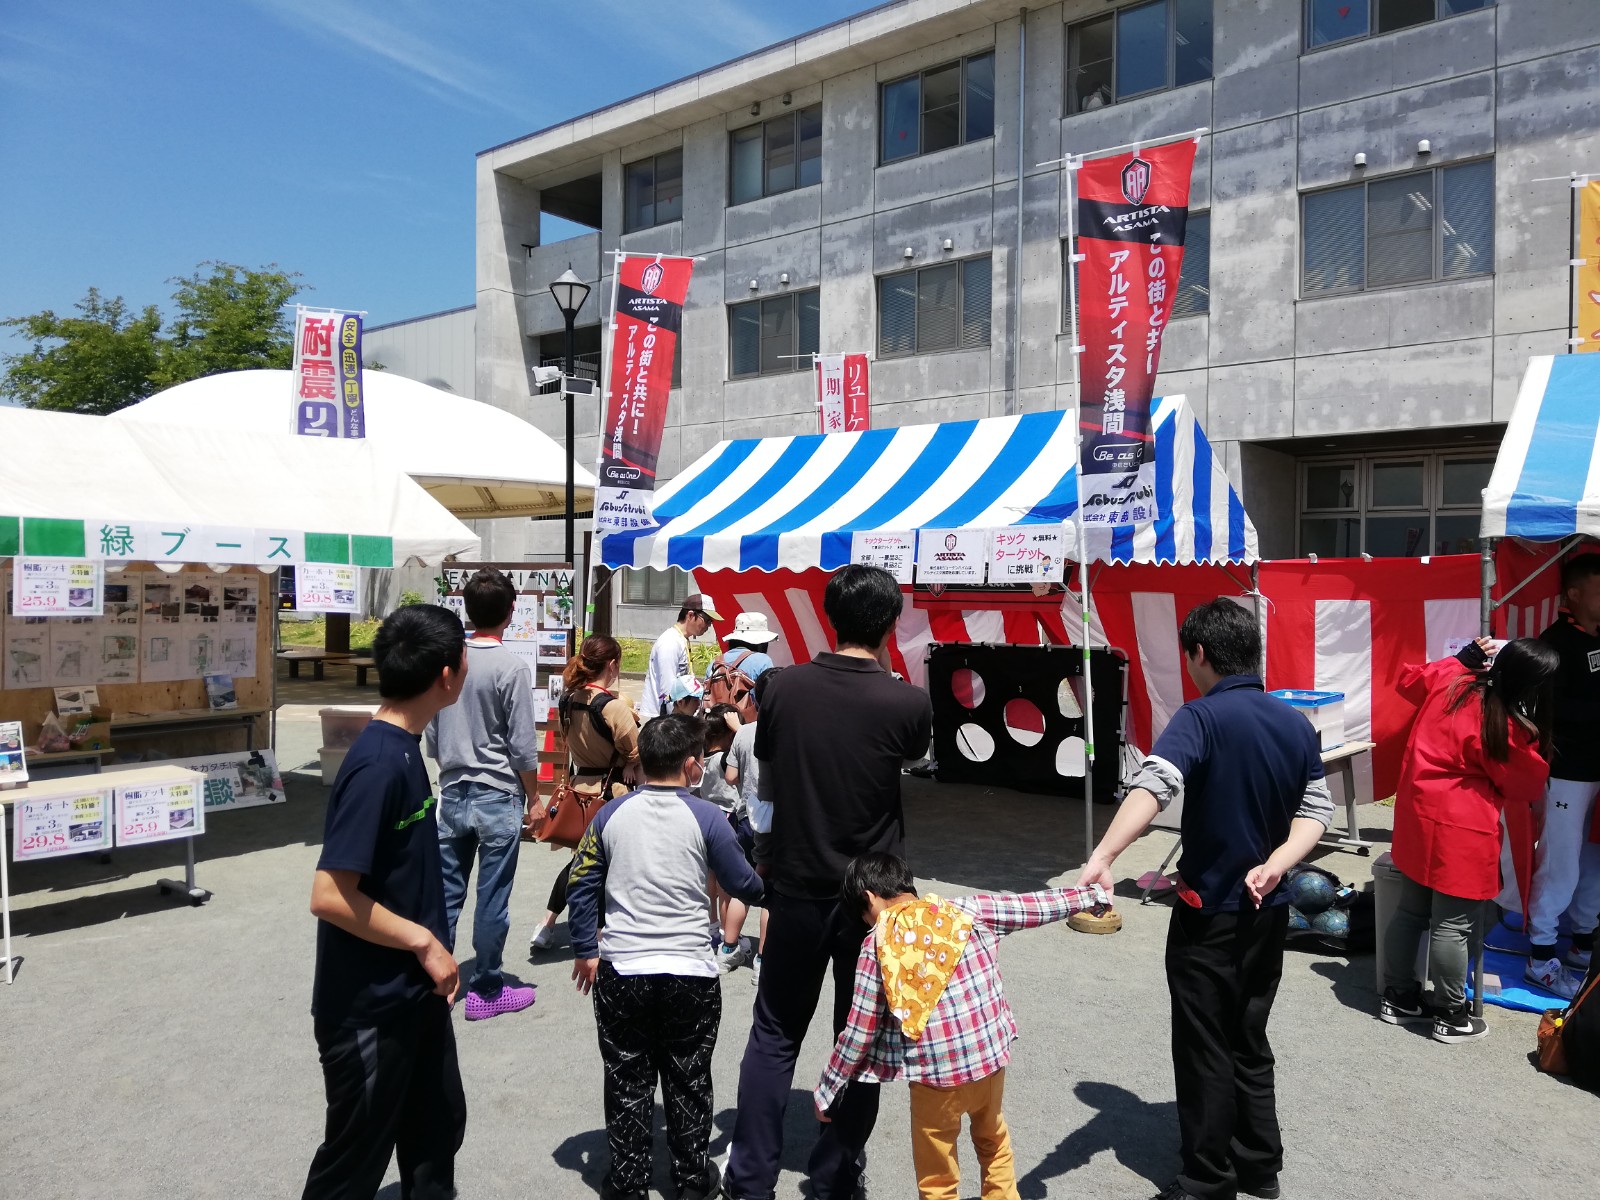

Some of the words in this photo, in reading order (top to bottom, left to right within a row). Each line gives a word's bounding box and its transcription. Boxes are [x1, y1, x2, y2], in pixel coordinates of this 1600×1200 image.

[1103, 205, 1170, 224] ARTISTA
[1113, 217, 1159, 232] ASAMA
[344, 321, 356, 344] 安全
[1102, 250, 1131, 436] アルティスタ浅間
[632, 316, 660, 435] この街と共に!
[612, 324, 638, 460] アルティスタ浅間
[1098, 451, 1114, 460] Be
[100, 524, 292, 559] 緑ブース
[864, 536, 903, 544] キックターゲット
[996, 533, 1026, 546] キック
[996, 548, 1045, 561] ターゲット
[22, 596, 57, 607] 25.9
[303, 593, 332, 603] 29.8
[124, 821, 158, 836] 25.9
[23, 833, 66, 850] 29.8
